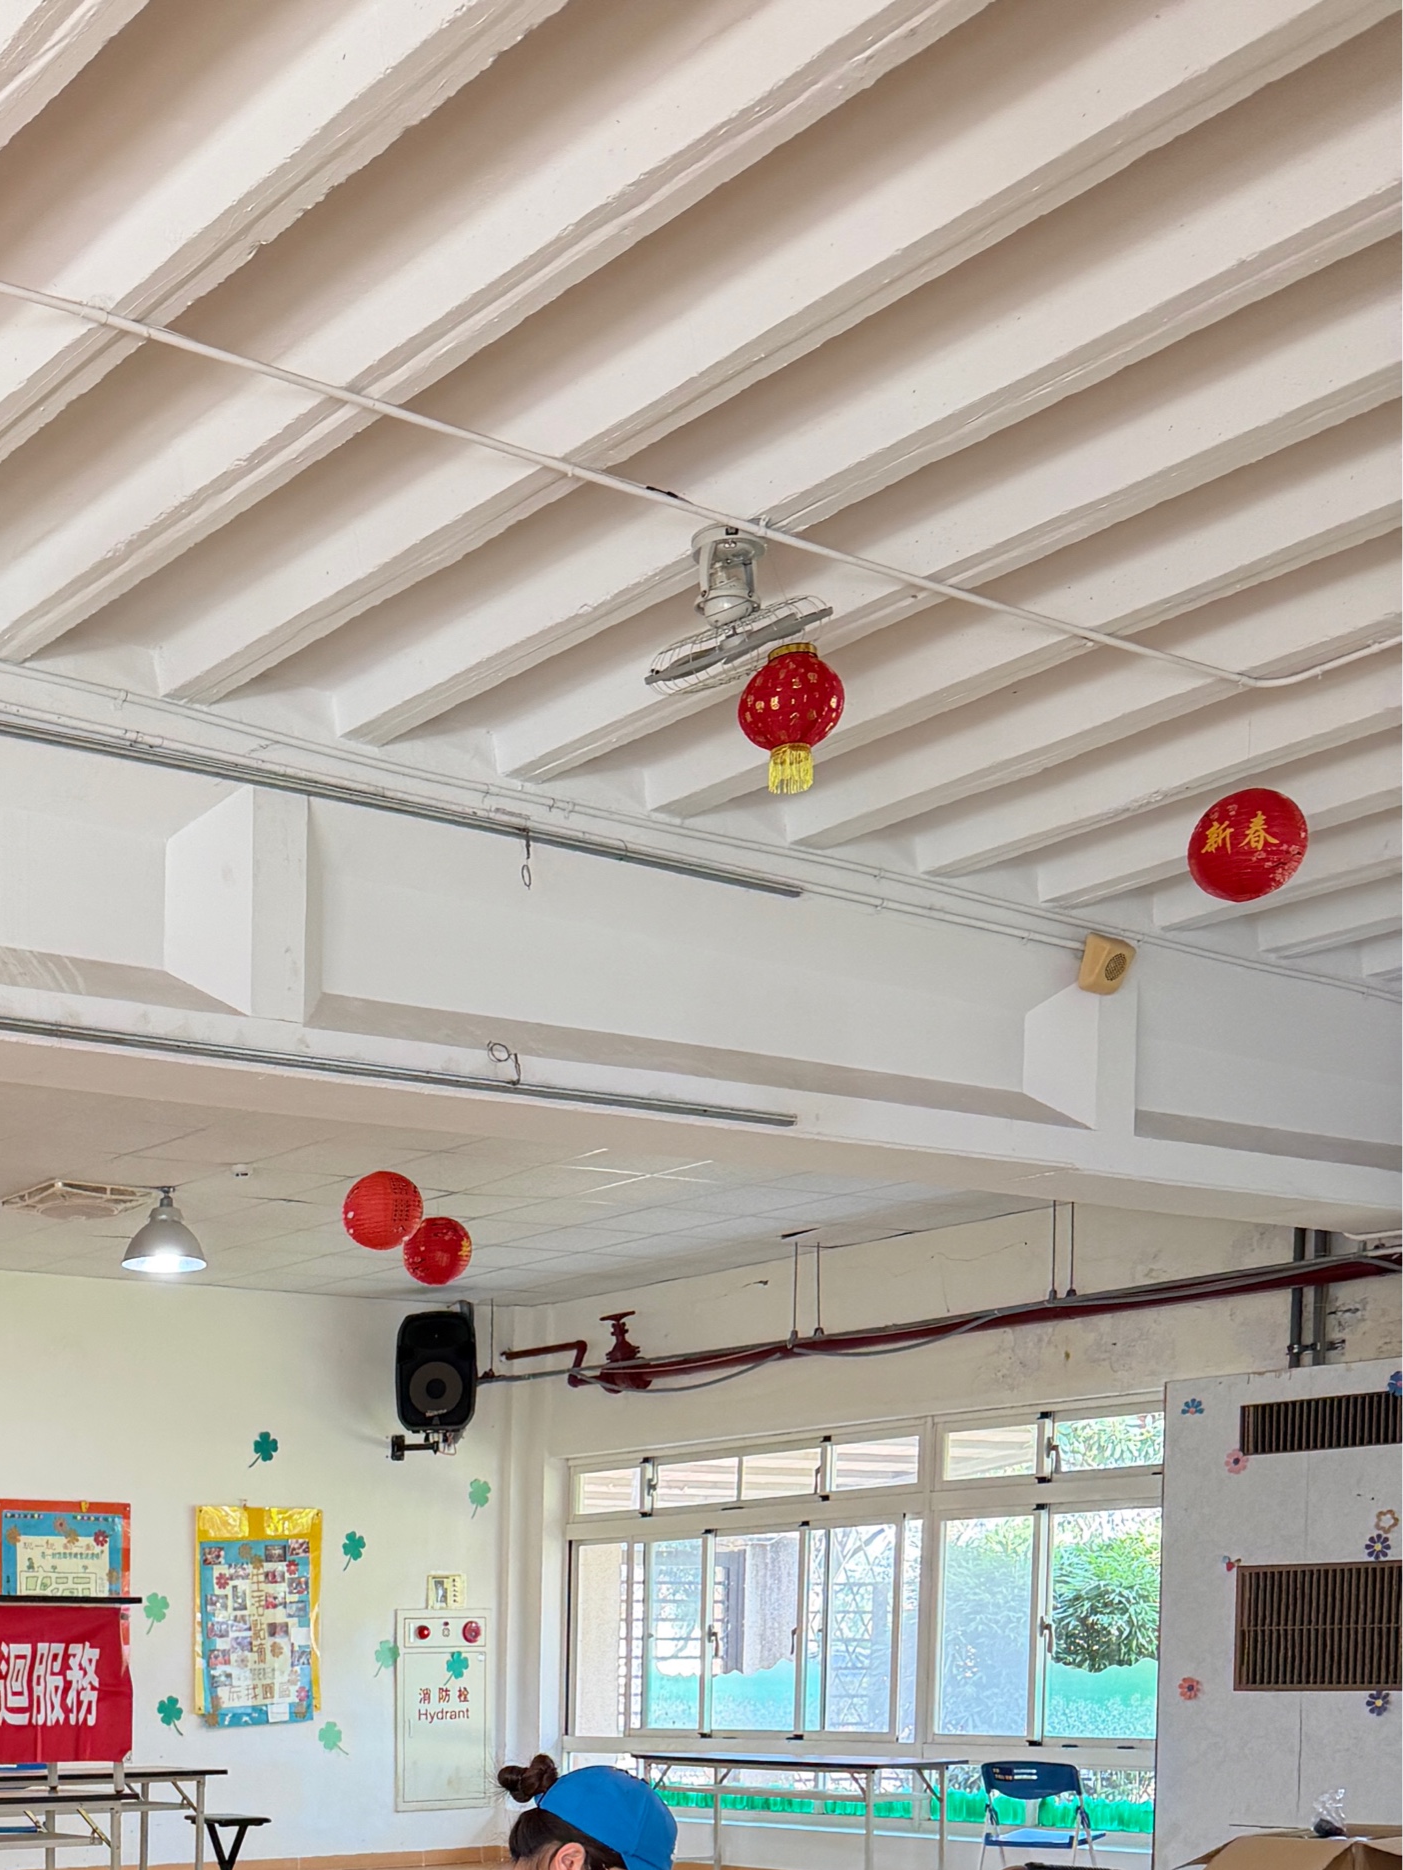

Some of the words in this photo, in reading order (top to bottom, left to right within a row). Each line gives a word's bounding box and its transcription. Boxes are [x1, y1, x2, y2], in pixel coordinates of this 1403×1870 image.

[1200, 811, 1280, 854] 新春
[418, 1686, 470, 1704] 消防栓
[418, 1708, 470, 1724] Hydrant
